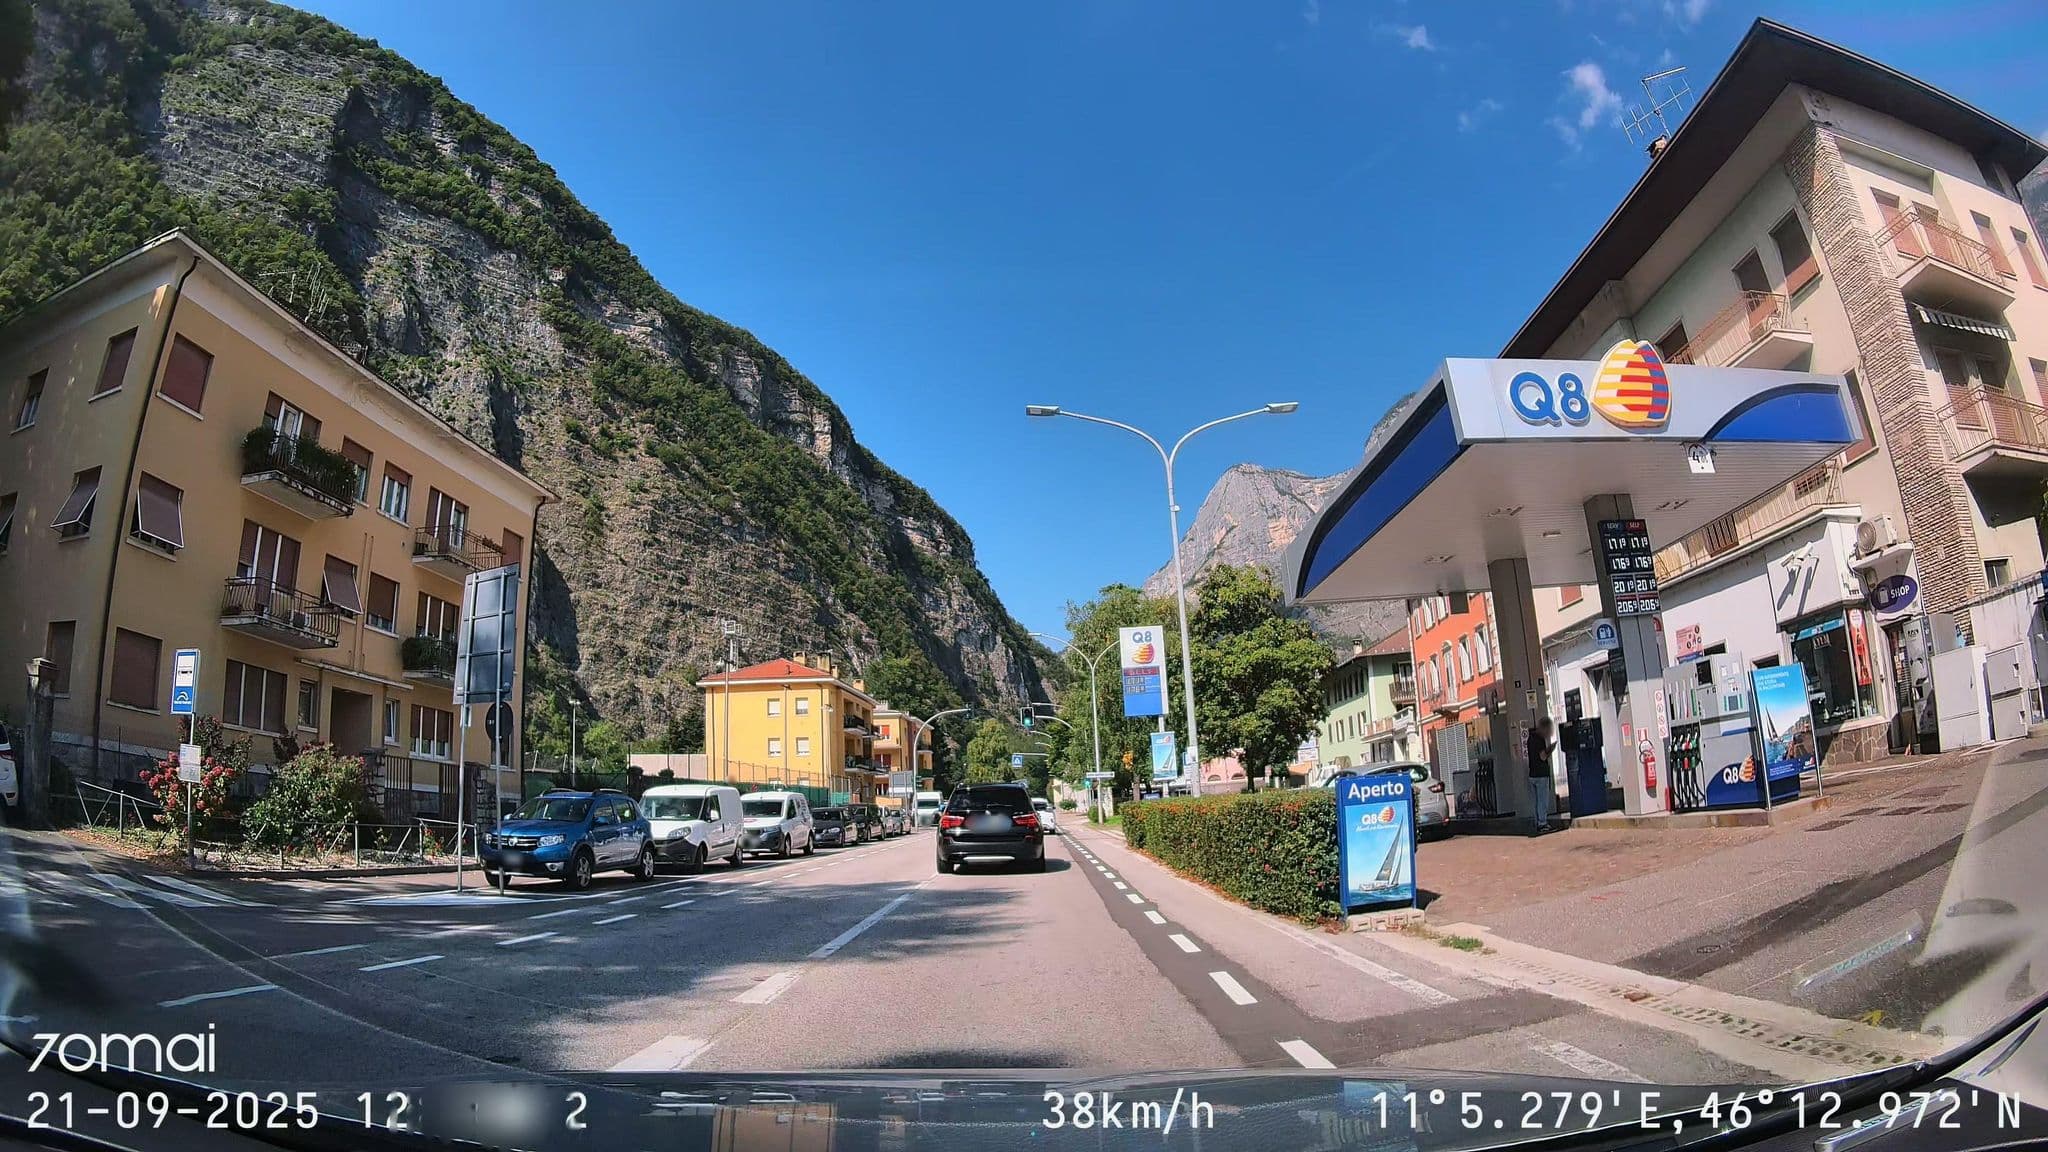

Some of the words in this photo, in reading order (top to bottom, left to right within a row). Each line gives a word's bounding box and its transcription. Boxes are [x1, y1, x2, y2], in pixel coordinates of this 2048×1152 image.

[1508, 371, 1591, 426] Q8
[1890, 584, 1910, 599] SHOP
[1132, 631, 1153, 644] Q8
[1723, 766, 1739, 785] Q8
[1348, 781, 1405, 803] Aperto
[1361, 813, 1378, 825] Q8
